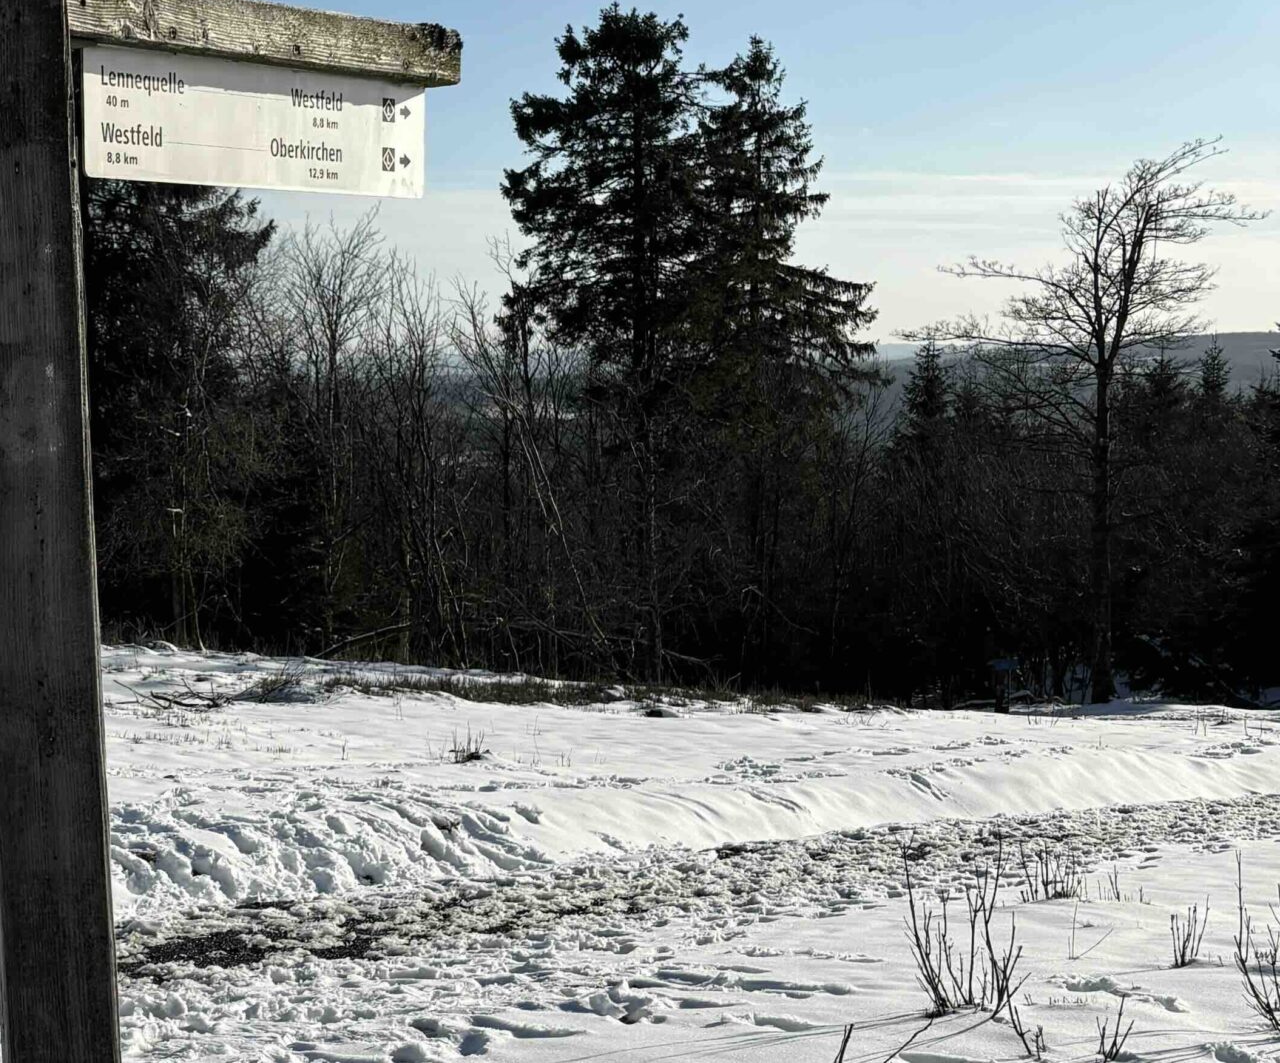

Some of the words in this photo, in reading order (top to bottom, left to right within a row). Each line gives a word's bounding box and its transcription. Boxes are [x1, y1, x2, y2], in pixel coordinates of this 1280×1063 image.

[101, 65, 185, 96] Lennequelle
[106, 95, 117, 108] 40
[120, 98, 129, 108] m
[291, 88, 343, 112] Westfeld
[327, 118, 338, 129] km
[101, 122, 163, 147] Westfeld
[107, 152, 121, 165] 8,8
[124, 153, 138, 165] km
[270, 138, 343, 162] Oberkirchen
[309, 168, 324, 180] 12,9
[326, 168, 338, 180] km
